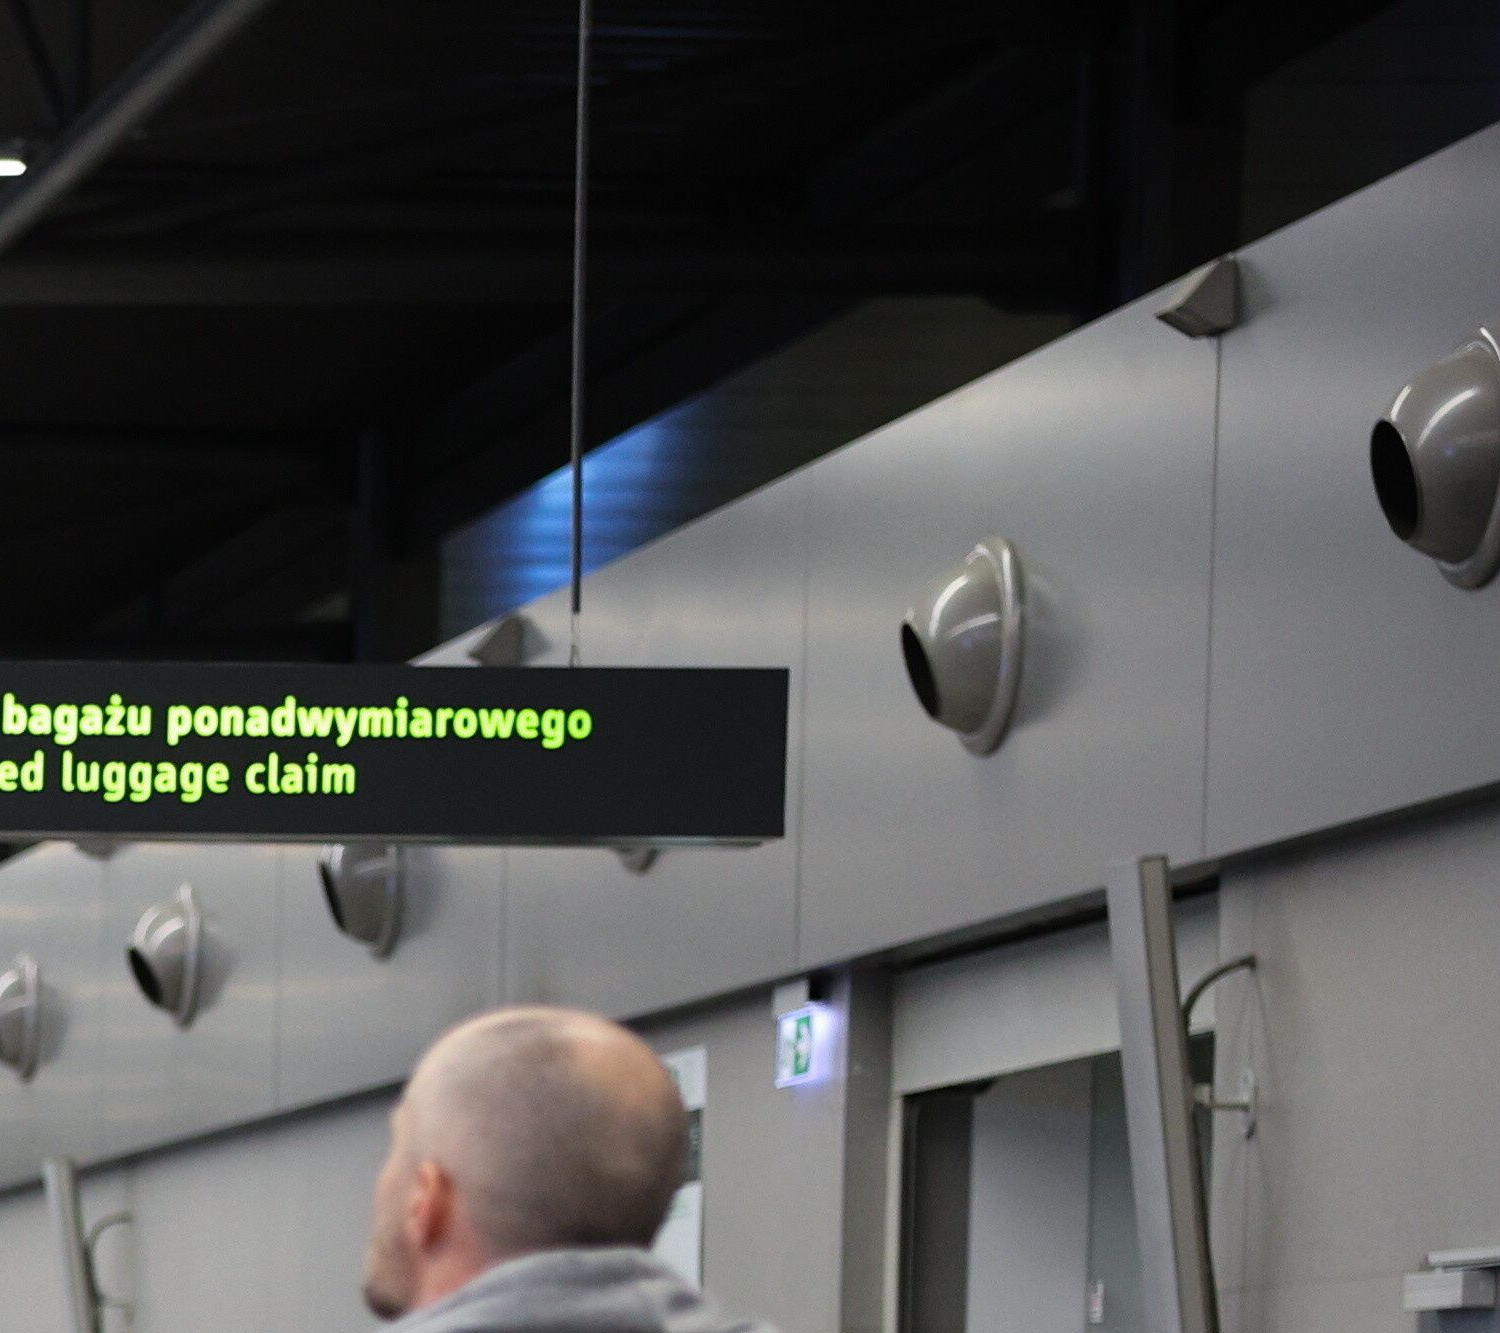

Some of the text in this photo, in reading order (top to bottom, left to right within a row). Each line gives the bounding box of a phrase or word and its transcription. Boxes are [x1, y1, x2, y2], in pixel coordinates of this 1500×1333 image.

[2, 693, 151, 745] bagażu
[167, 695, 592, 749] ponadwymiarowego
[62, 750, 229, 803] luggage
[245, 752, 355, 794] claim
